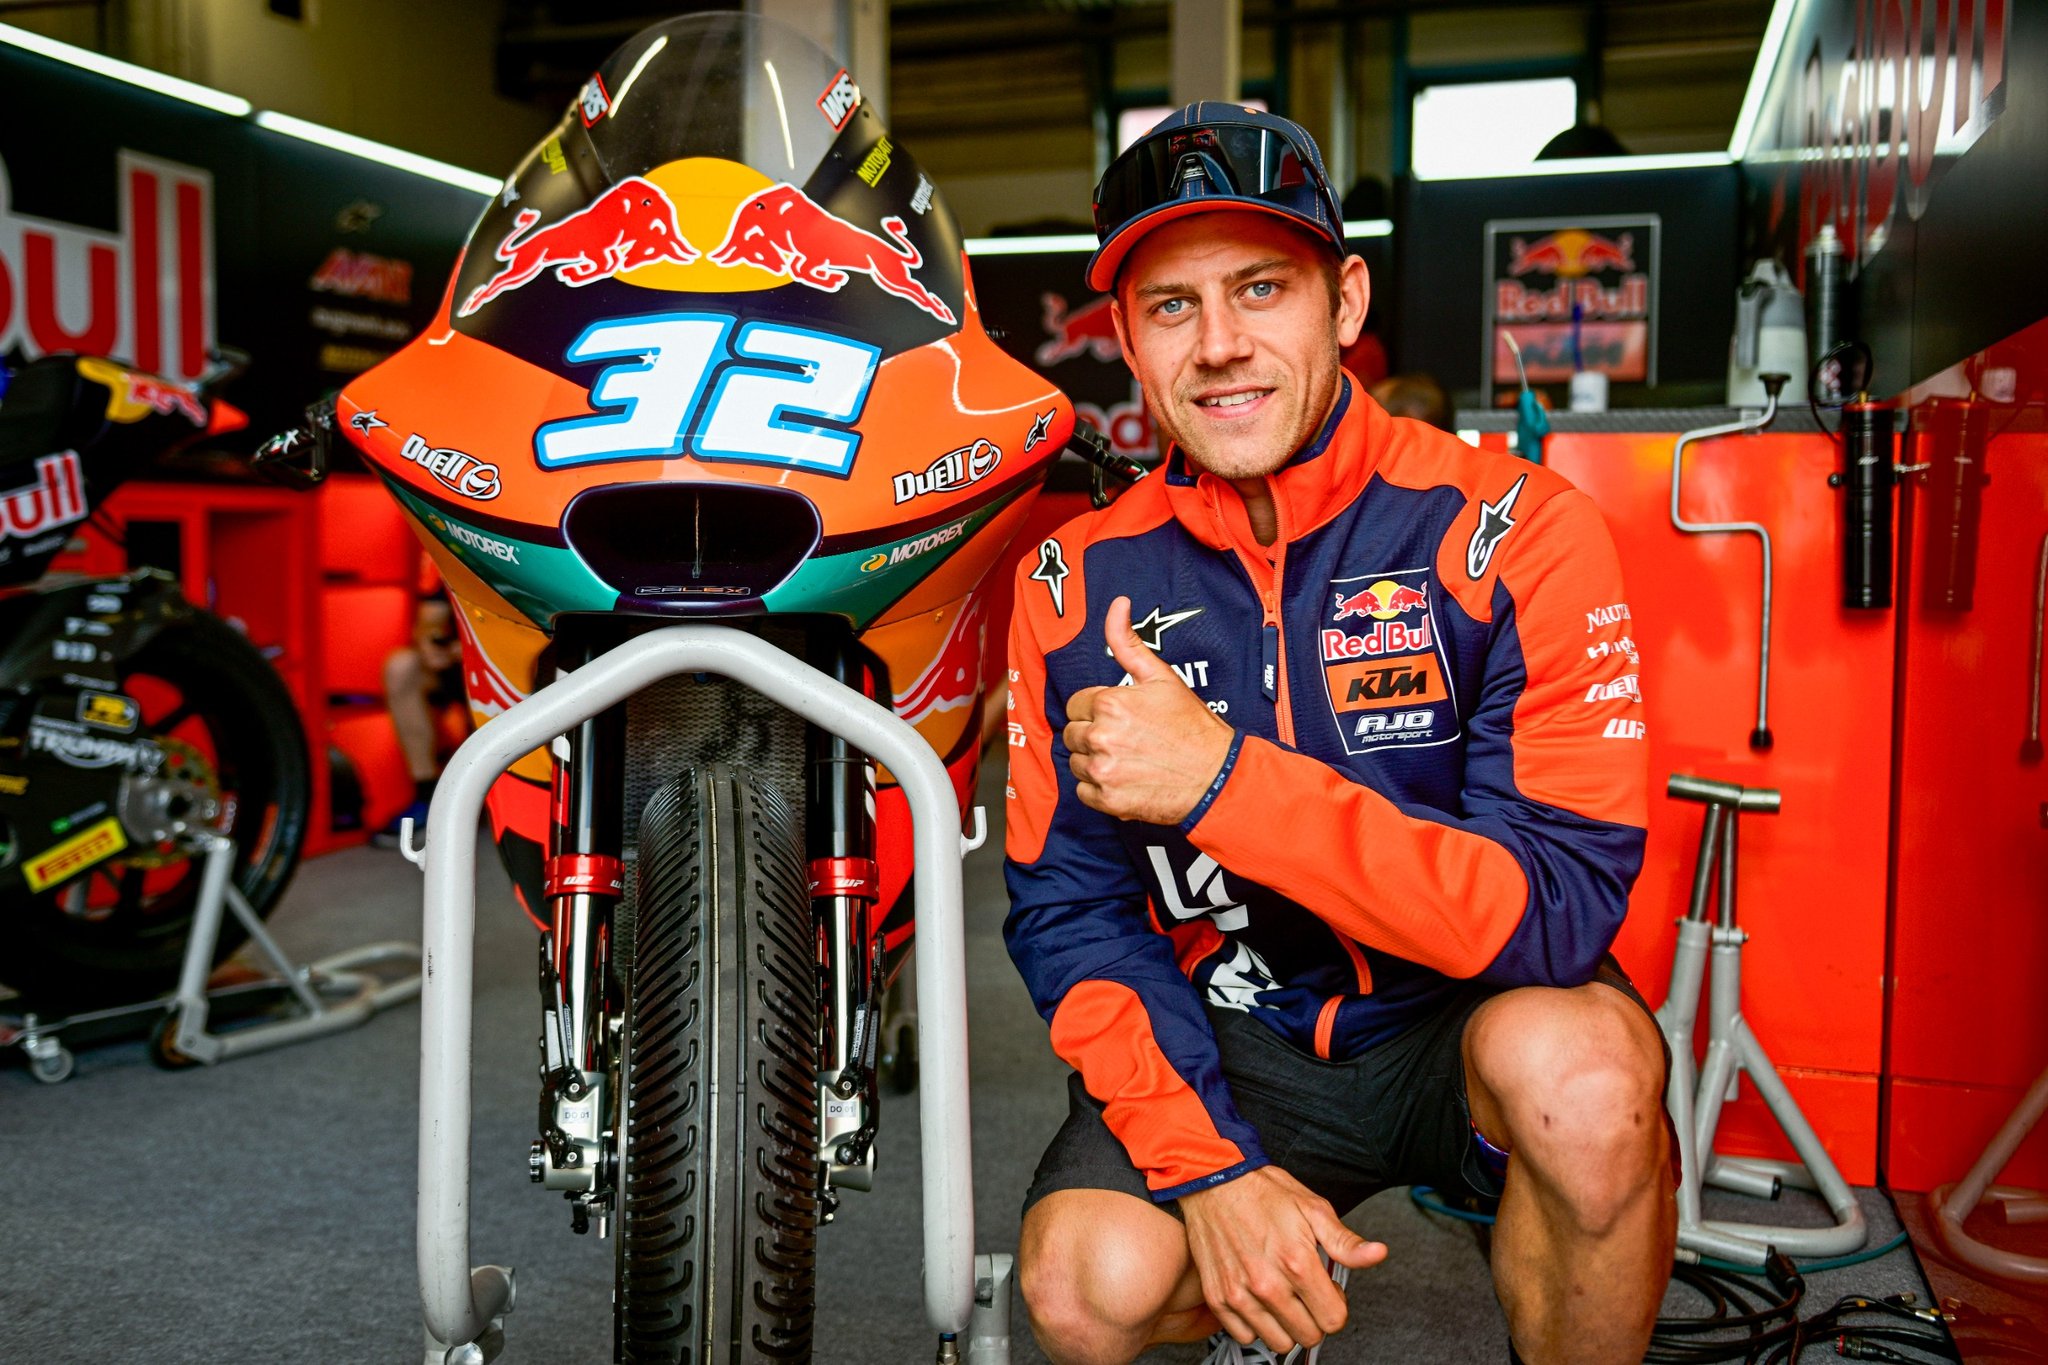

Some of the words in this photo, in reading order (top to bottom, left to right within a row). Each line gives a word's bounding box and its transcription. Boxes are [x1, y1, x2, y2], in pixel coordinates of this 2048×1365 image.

[0, 150, 213, 378] ull
[1497, 279, 1571, 322] Red
[1574, 275, 1648, 320] Bull
[535, 312, 882, 477] 32
[0, 451, 88, 538] ull
[444, 519, 520, 566] MOTOREX
[889, 519, 969, 566] MOTOREX
[1322, 621, 1385, 661] Red
[1386, 613, 1433, 653] Bull
[1346, 666, 1426, 703] KTM
[1354, 709, 1434, 736] AJO
[1362, 729, 1434, 744] motorsport
